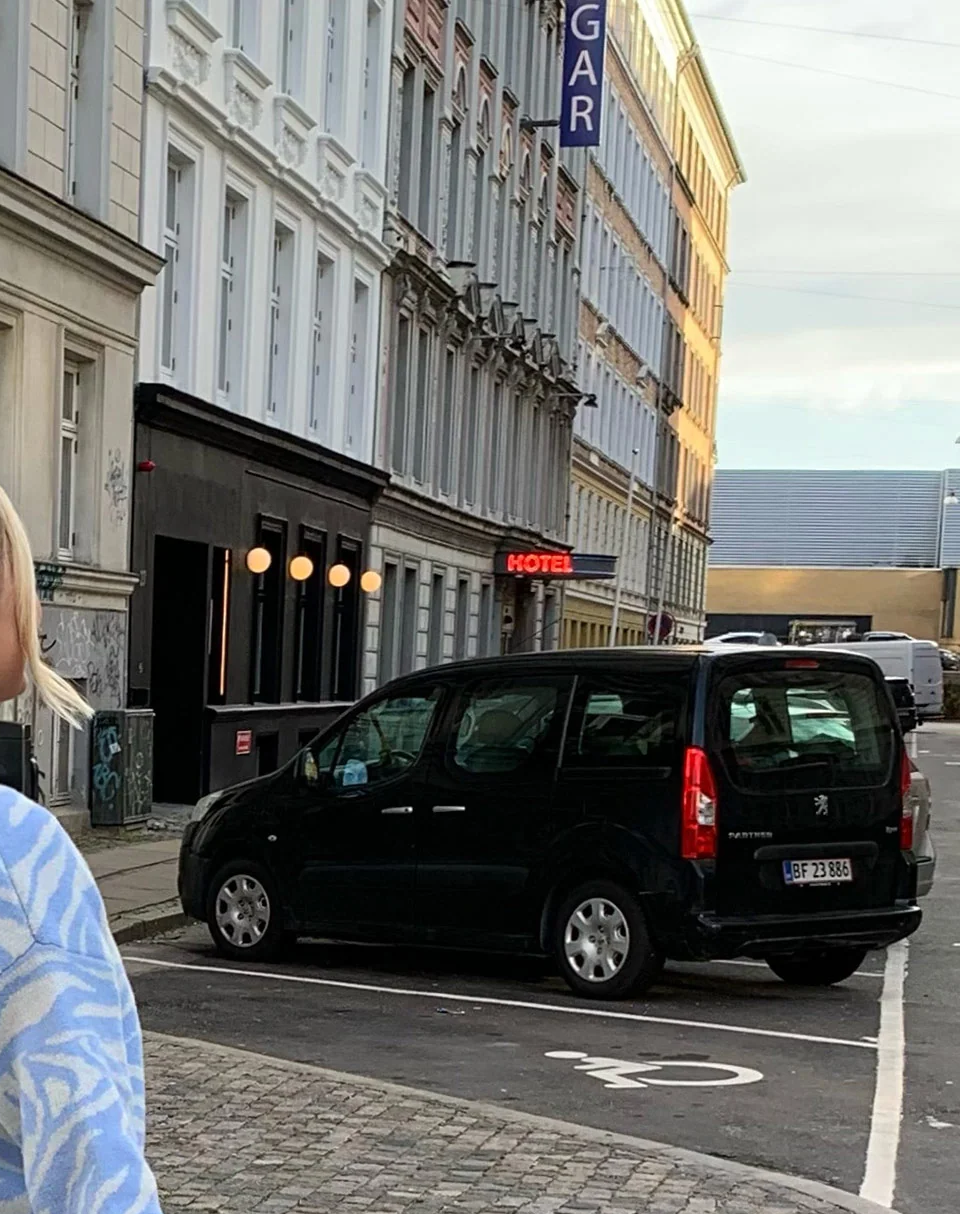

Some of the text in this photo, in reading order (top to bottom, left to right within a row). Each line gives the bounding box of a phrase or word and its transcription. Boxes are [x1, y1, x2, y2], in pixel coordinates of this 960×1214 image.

[568, 3, 600, 132] GAR
[507, 553, 573, 573] HOTEL
[793, 862, 849, 879] BF 23 886
